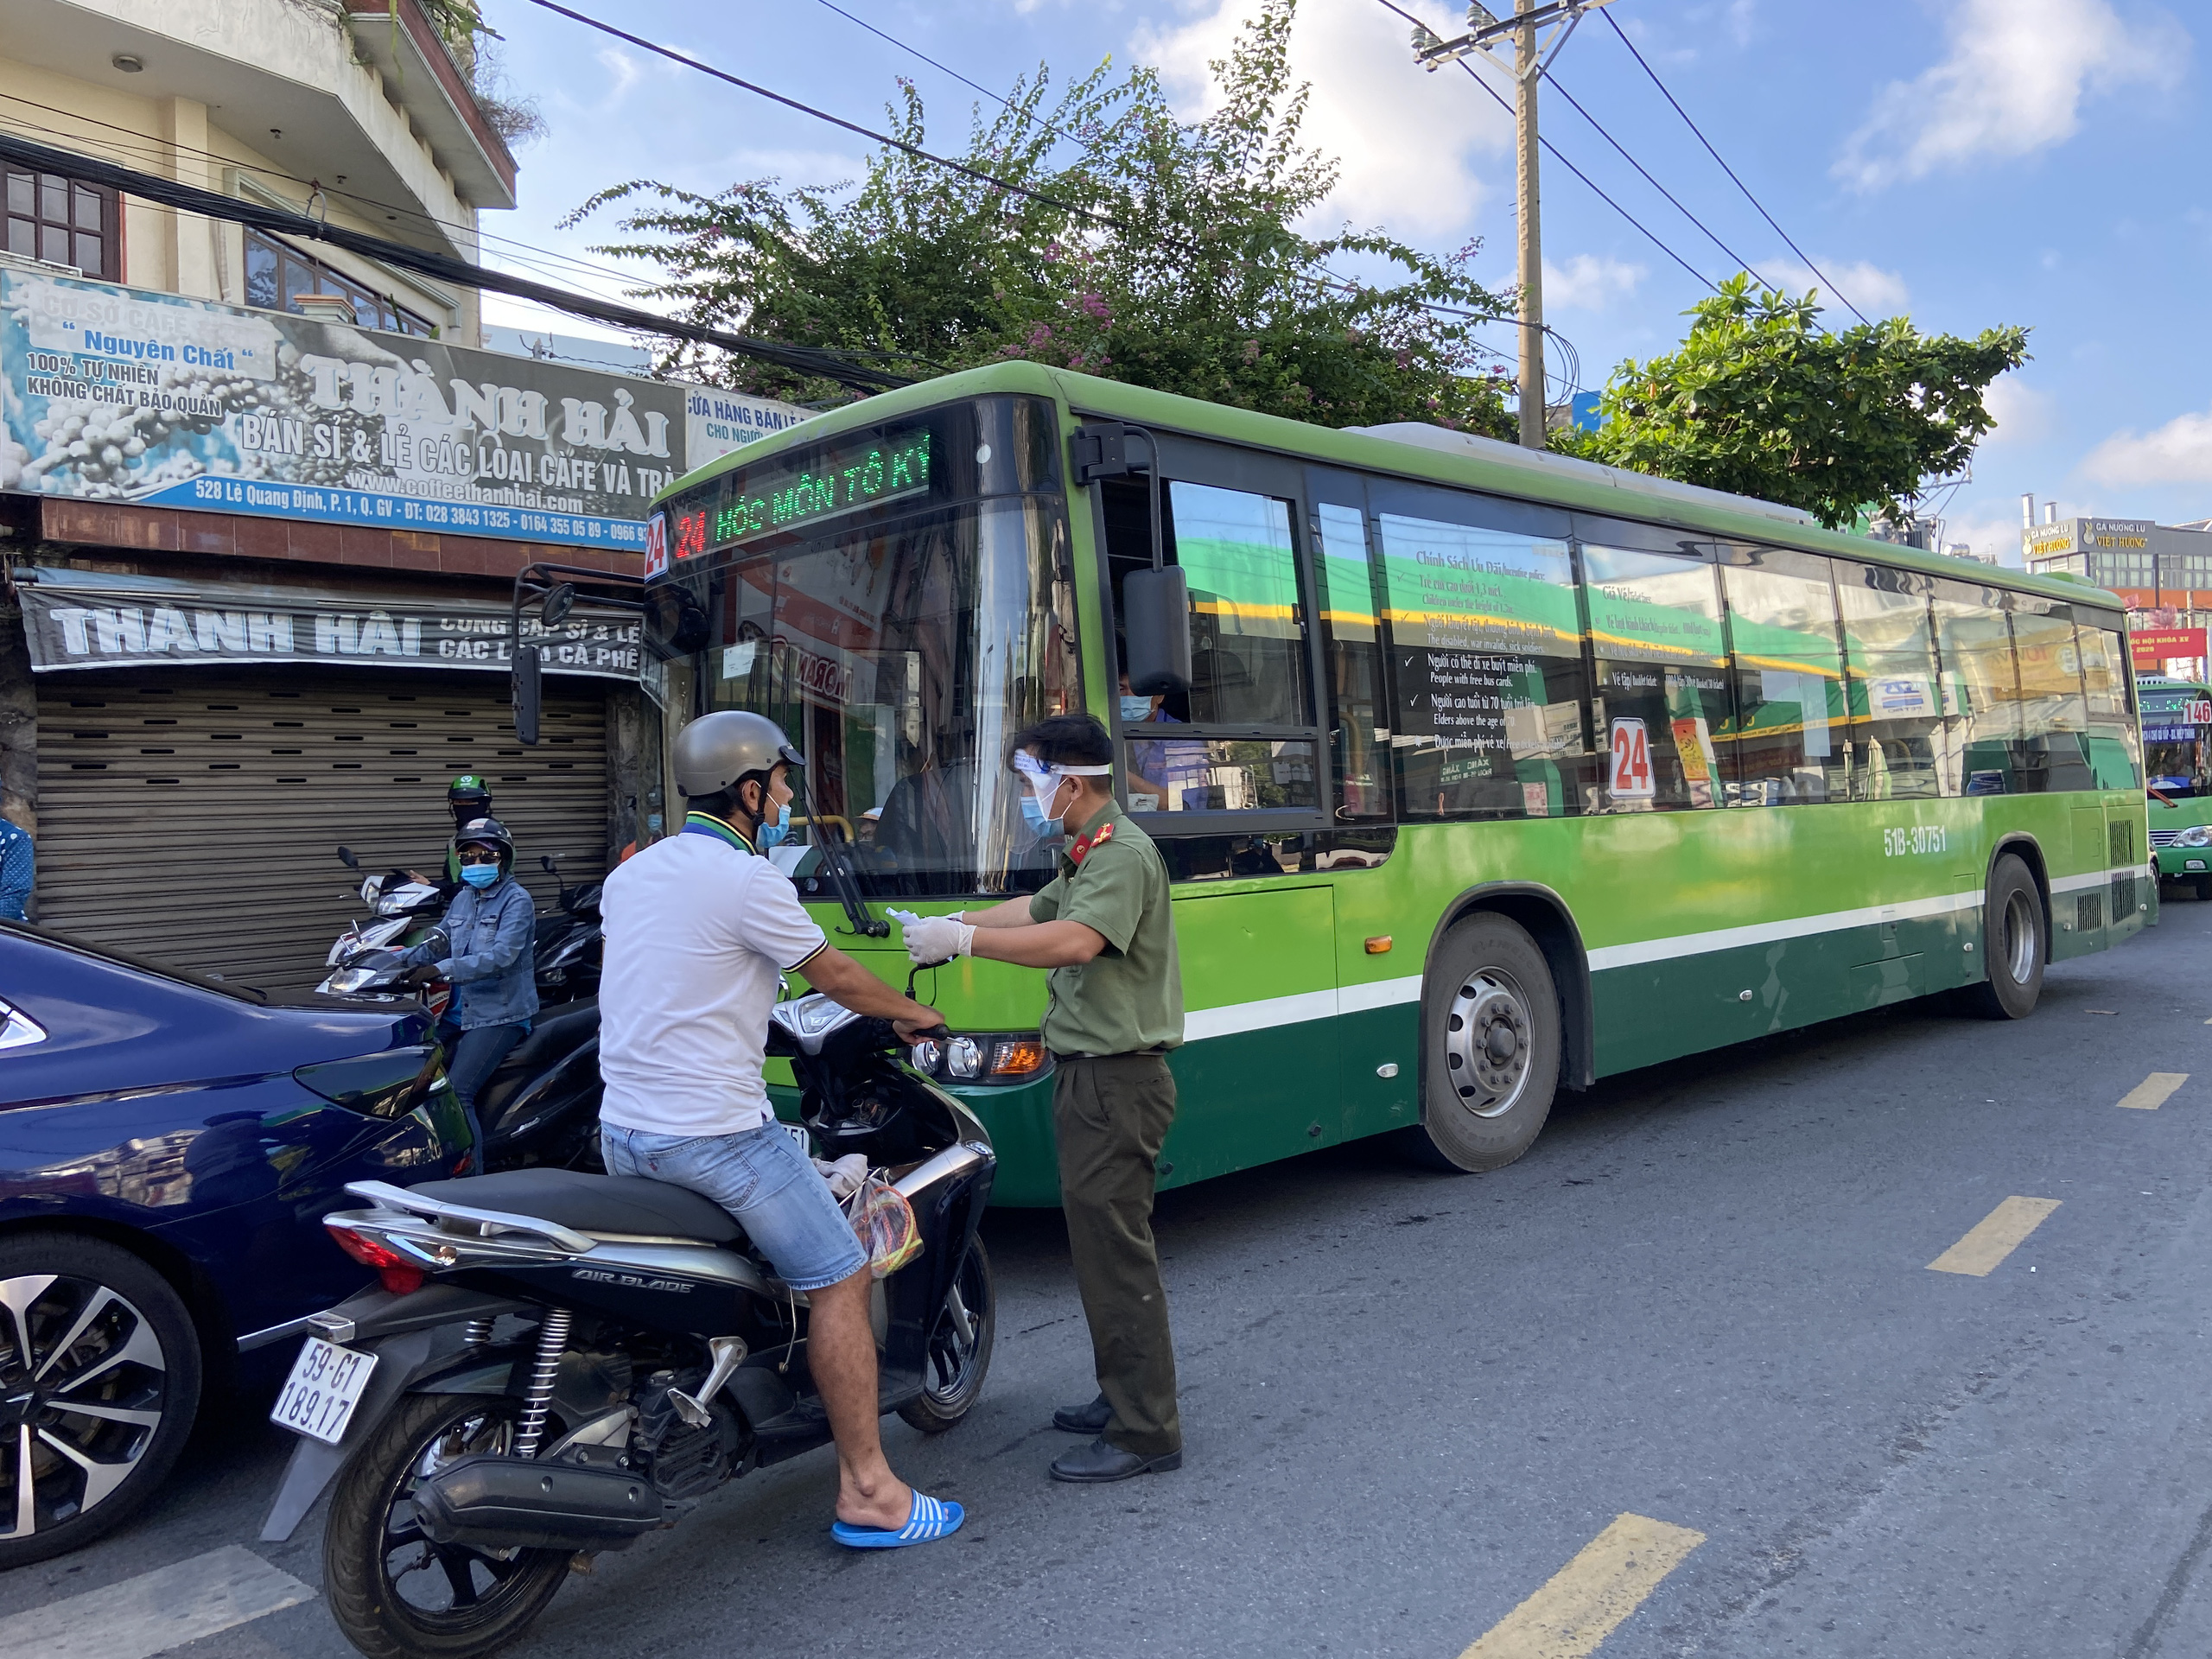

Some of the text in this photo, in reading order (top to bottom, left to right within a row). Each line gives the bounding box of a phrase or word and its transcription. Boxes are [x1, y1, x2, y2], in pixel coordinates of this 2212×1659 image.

[85, 330, 234, 371] Nguyên Chất
[27, 353, 159, 385] 100% TỰ NHIÊN
[27, 376, 221, 416] KHÔNG CHẤT BẢO QUẢN
[300, 353, 671, 458] THÀNH HẢI
[714, 399, 752, 425] HÀNG
[754, 407, 783, 430] BÁN
[706, 423, 729, 441] CHO
[241, 409, 304, 456] BÁN
[312, 414, 342, 461] SỈ
[350, 429, 372, 464] &
[380, 423, 412, 470] LẺ
[418, 434, 472, 477] CÁC
[540, 450, 597, 492] CÀFE
[602, 459, 632, 496] VÀ
[346, 472, 584, 514] www.coffeethanhhai.com
[676, 511, 707, 560] 24
[715, 494, 766, 543] HÓC
[772, 473, 835, 524] MÔN
[843, 450, 884, 502] TÔ
[195, 479, 222, 500] 528
[226, 481, 243, 503] Lê
[246, 486, 290, 509] Quang
[293, 489, 327, 514] Định,
[330, 493, 342, 512] P.
[360, 496, 373, 517] Q.
[377, 498, 393, 518] GV
[404, 503, 423, 521] ĐT:
[426, 505, 448, 524] 028
[451, 507, 480, 526] 3843
[483, 510, 510, 529] 1325
[520, 513, 548, 533] 0164
[550, 516, 569, 536] 355
[572, 519, 586, 537] 05
[588, 521, 601, 538] 89
[610, 523, 635, 541] 0966
[2095, 521, 2107, 532] GÀ
[2137, 524, 2145, 533] LU
[2095, 533, 2116, 550] VIỆT
[1416, 550, 1445, 569] Chính
[1446, 554, 1469, 571] Sách
[593, 625, 608, 641] &
[617, 620, 640, 645] LẺ
[1427, 633, 1440, 645] The
[1440, 635, 1468, 648] disabled,
[1471, 639, 1482, 649] war
[438, 636, 490, 660] CÁC
[558, 643, 589, 665] CÀ
[596, 649, 639, 671] PHÊ
[1427, 652, 1449, 672] Người
[1451, 654, 1459, 669] có
[1473, 657, 1481, 671] đi
[1482, 660, 1491, 671] xe
[1430, 671, 1513, 688] People with free bus cards.
[1431, 693, 1452, 713] Người
[1454, 696, 1466, 709] cao
[1491, 696, 1499, 710] 70
[2184, 702, 2211, 723] 146
[1433, 713, 1453, 726] Elders
[1455, 714, 1474, 727] above
[1476, 715, 1486, 727] the
[1487, 718, 1498, 729] age
[1499, 715, 1506, 727] of
[1473, 735, 1485, 753] phí
[1486, 736, 1495, 750] vé
[1614, 727, 1648, 790] 24
[1884, 824, 1946, 857] 51B-30751
[784, 1128, 804, 1150] 51
[571, 1268, 696, 1294] AIR BLADE
[302, 1343, 361, 1393] 59-G1
[278, 1381, 350, 1436] 189.17
